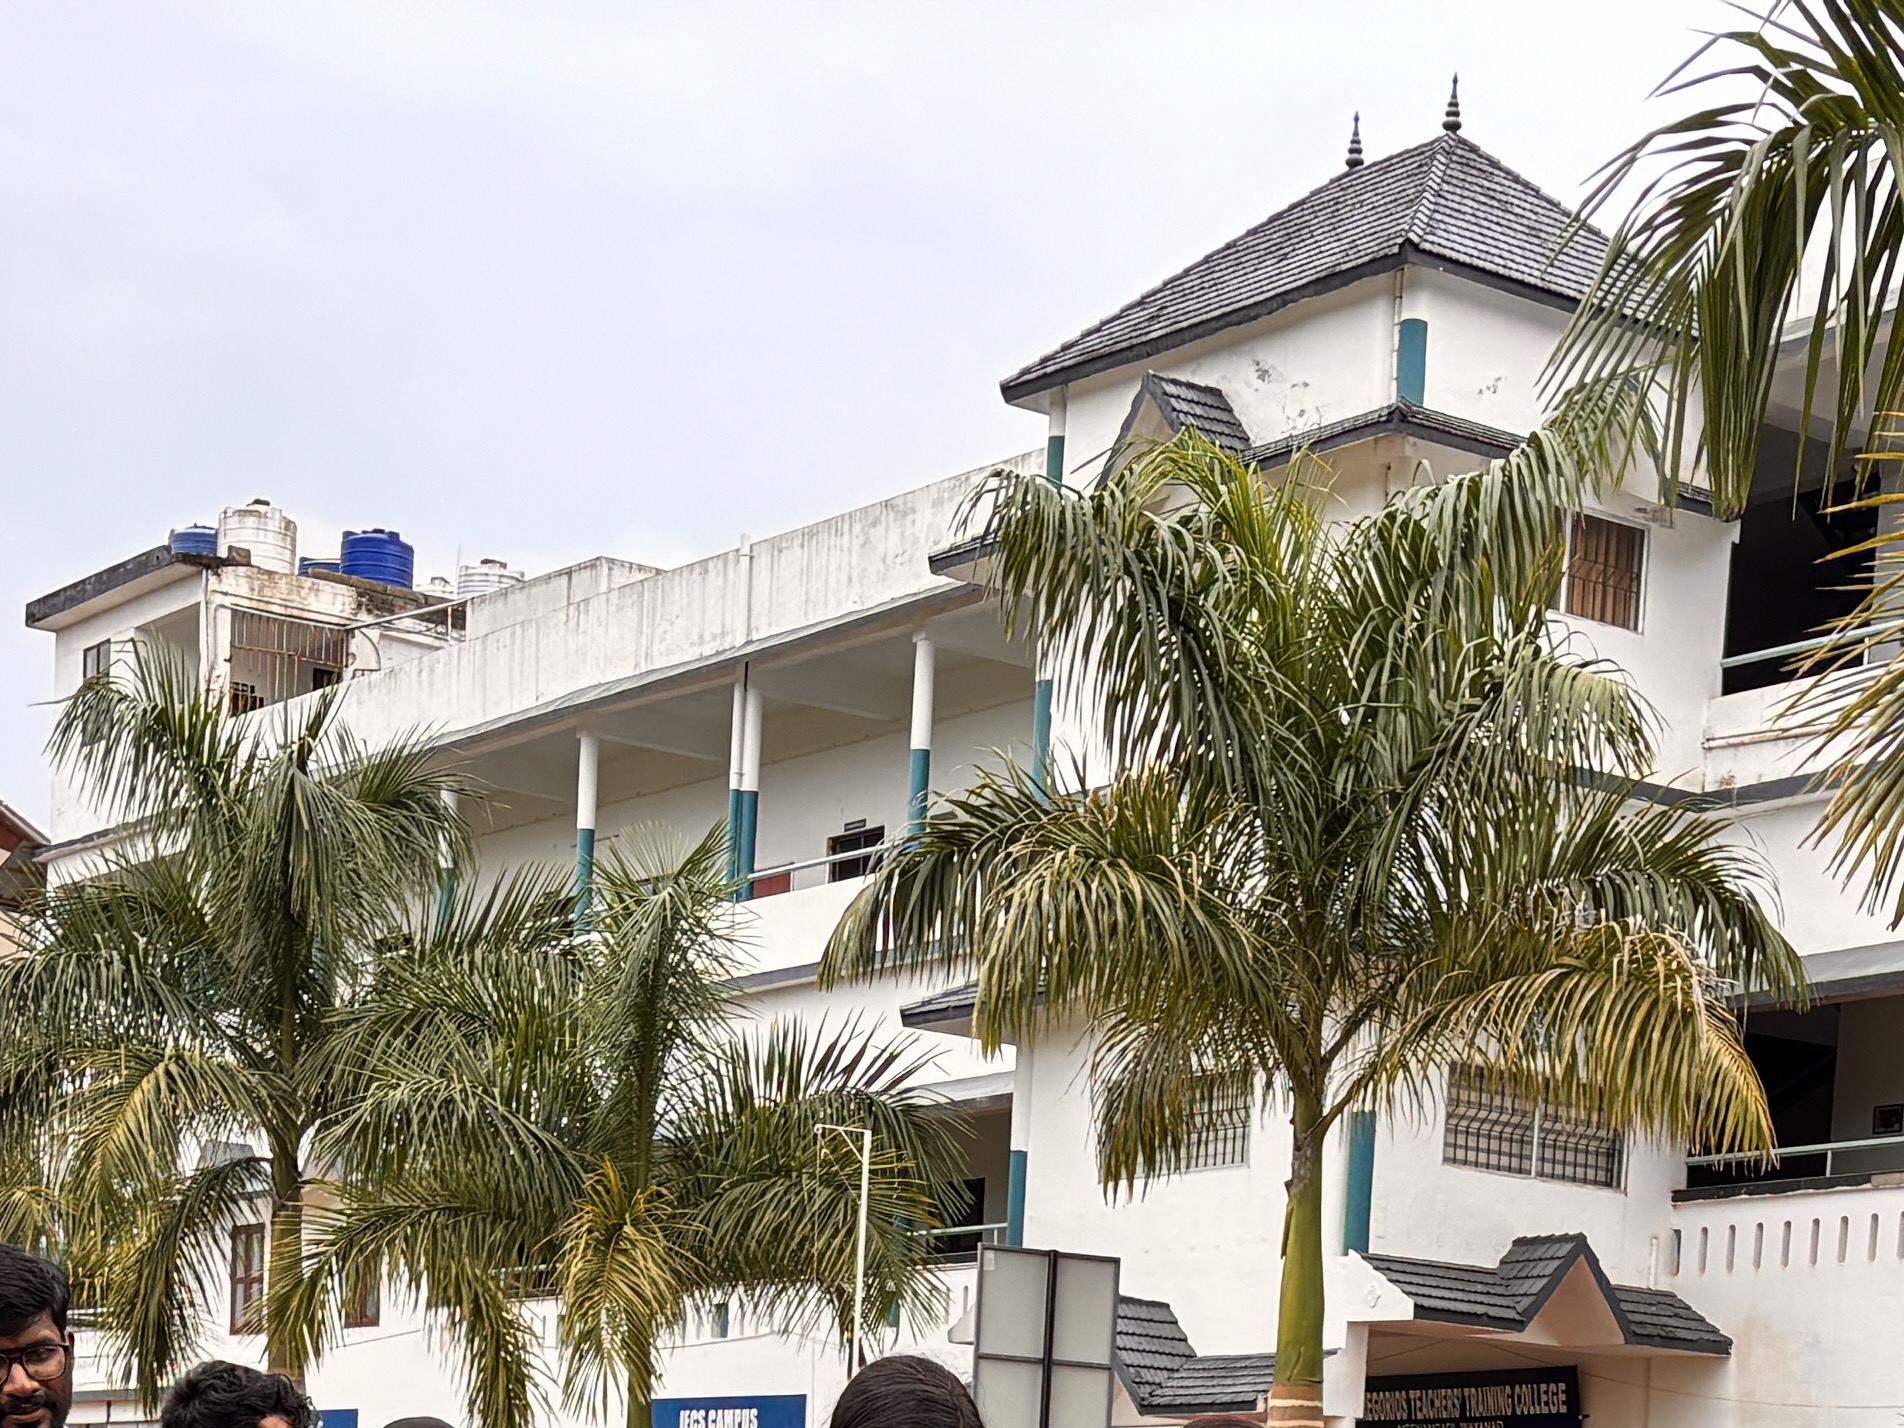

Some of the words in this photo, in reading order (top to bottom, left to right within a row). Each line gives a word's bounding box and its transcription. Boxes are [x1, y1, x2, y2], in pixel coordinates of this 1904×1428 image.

[1362, 1390, 1408, 1421] EGORIOS
[1463, 1384, 1512, 1418] TRAINING
[1514, 1382, 1567, 1416] COLLEGE
